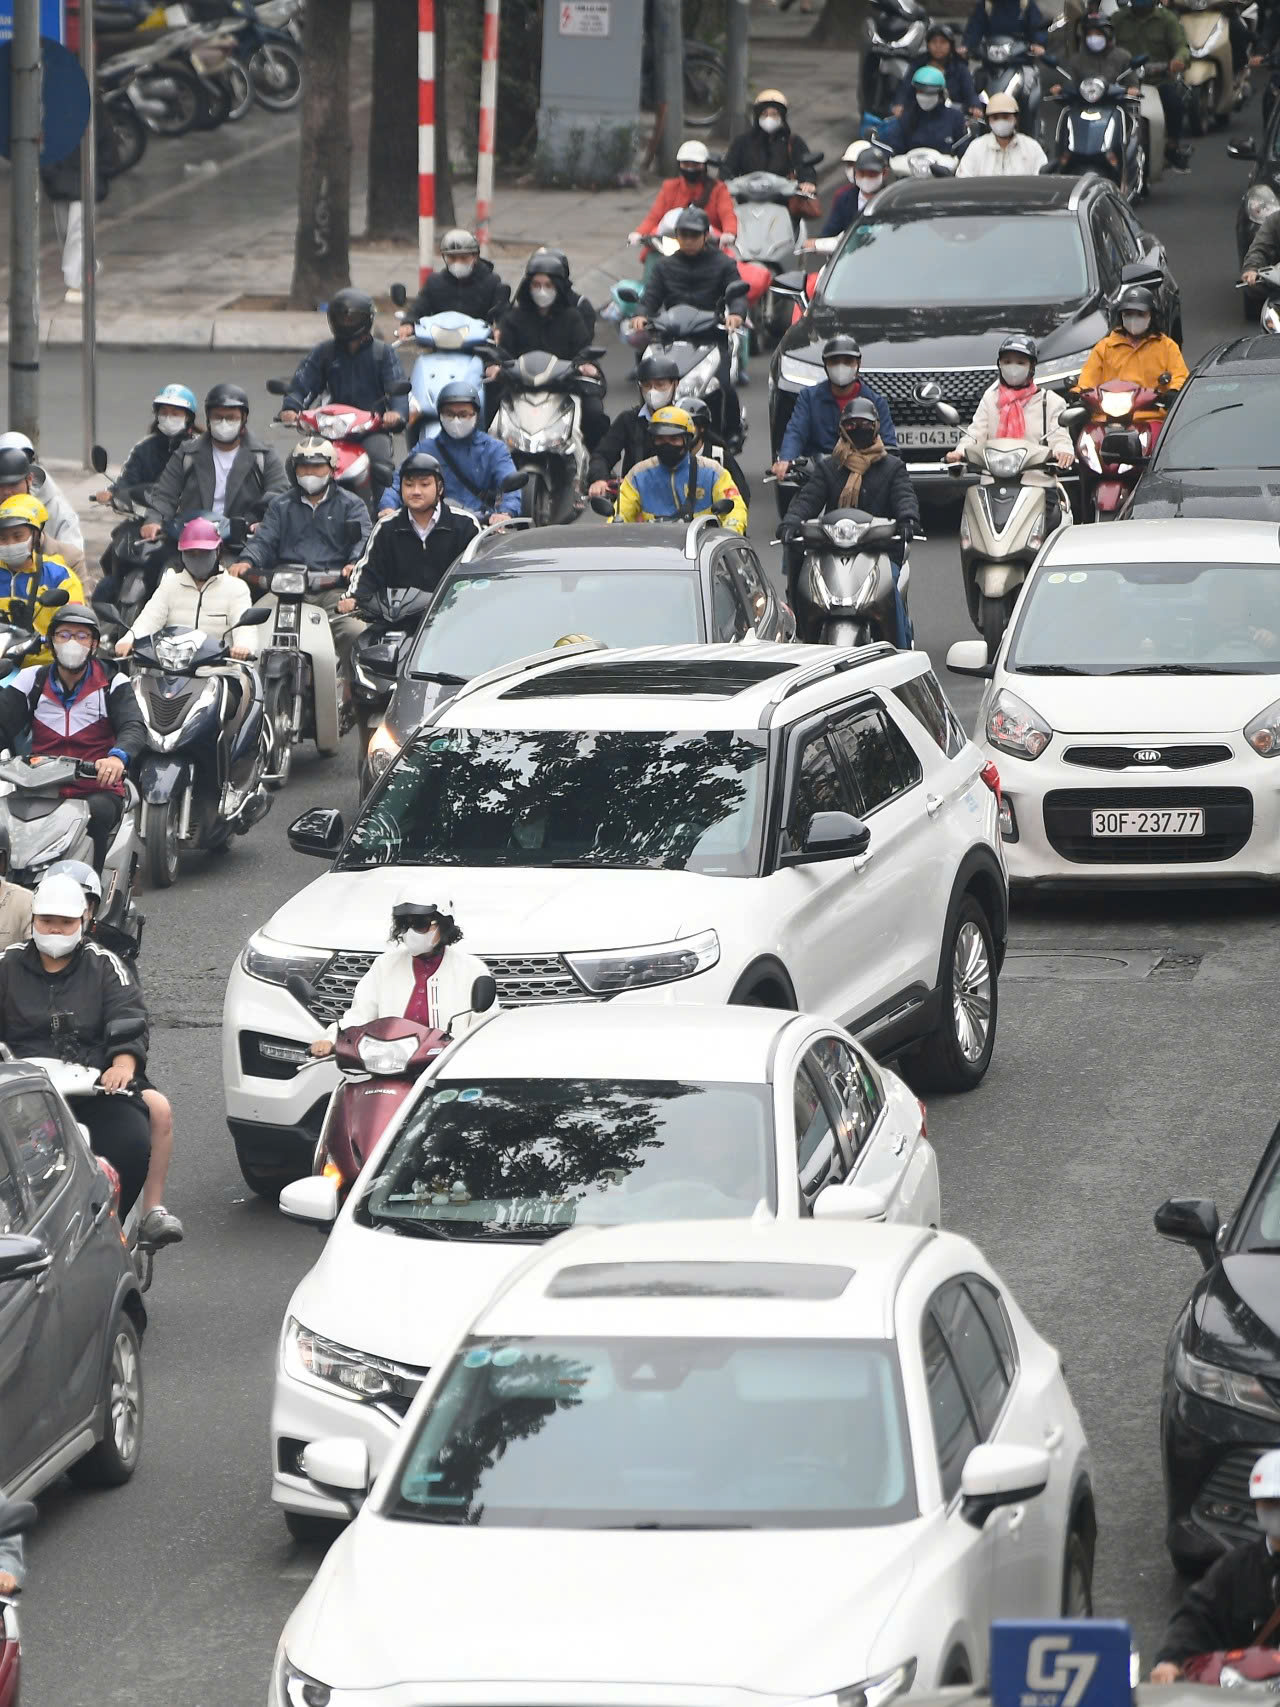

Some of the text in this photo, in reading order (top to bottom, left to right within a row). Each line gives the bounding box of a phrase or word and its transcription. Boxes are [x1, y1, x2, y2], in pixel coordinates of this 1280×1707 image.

[896, 431, 961, 446] 0E-043.5
[1137, 752, 1157, 761] KIA
[1095, 812, 1200, 833] 30F-237.77
[1026, 1635, 1097, 1707] G7
